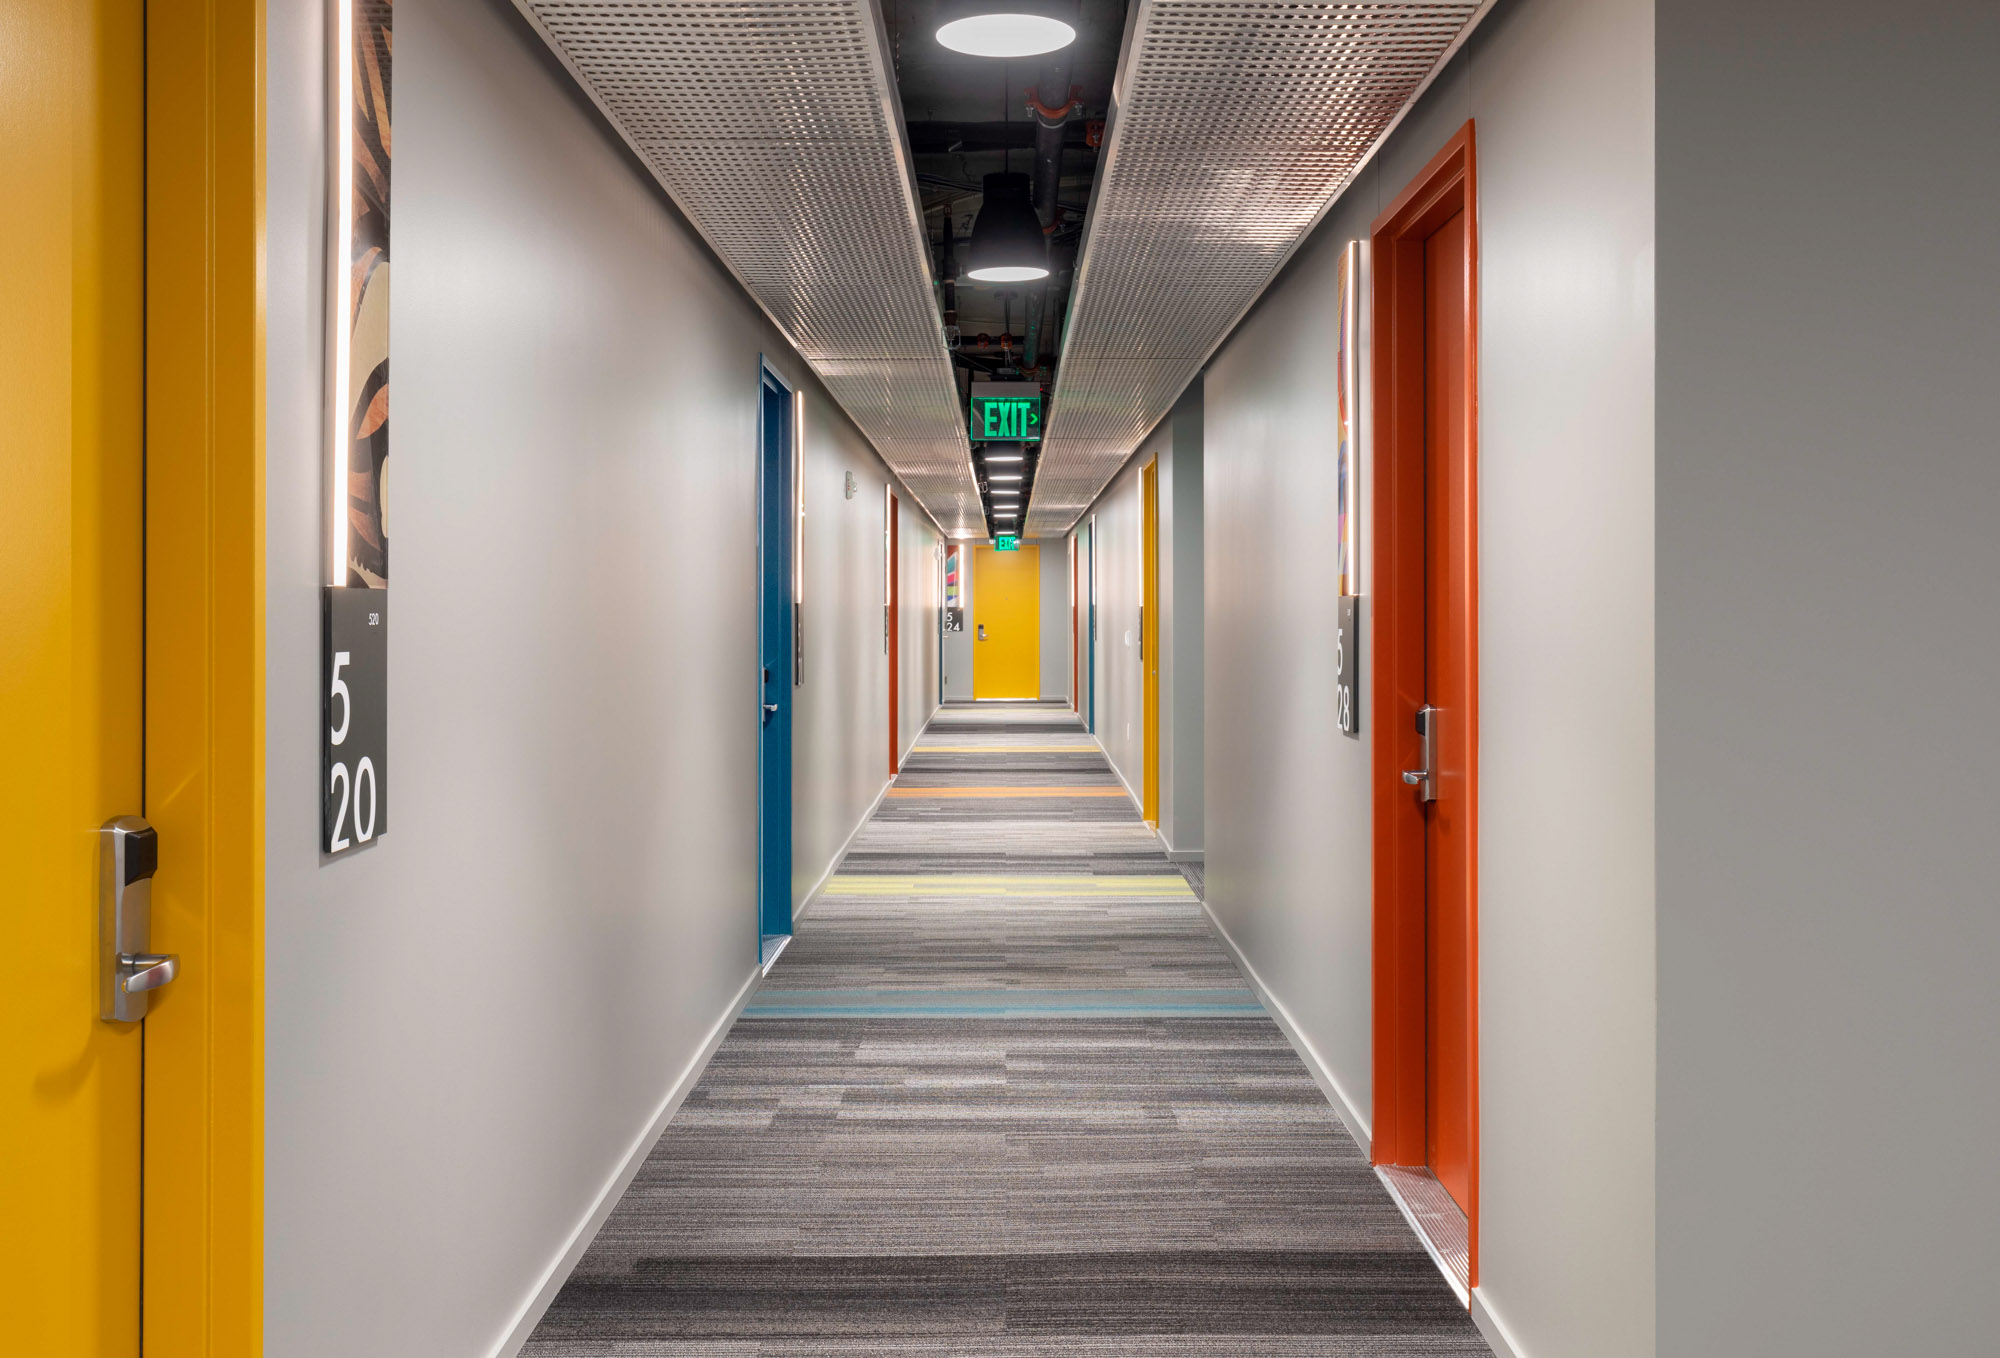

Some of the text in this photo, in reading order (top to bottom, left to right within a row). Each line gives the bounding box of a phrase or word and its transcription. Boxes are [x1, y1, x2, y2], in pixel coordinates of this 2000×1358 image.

[984, 402, 1030, 437] EXIT
[999, 536, 1016, 550] EXIT
[368, 612, 379, 626] 520
[947, 612, 953, 621] 5
[947, 622, 960, 632] 24
[1338, 629, 1343, 676] 5
[330, 651, 351, 746] 5
[1338, 684, 1350, 731] 28
[330, 756, 377, 853] 20
